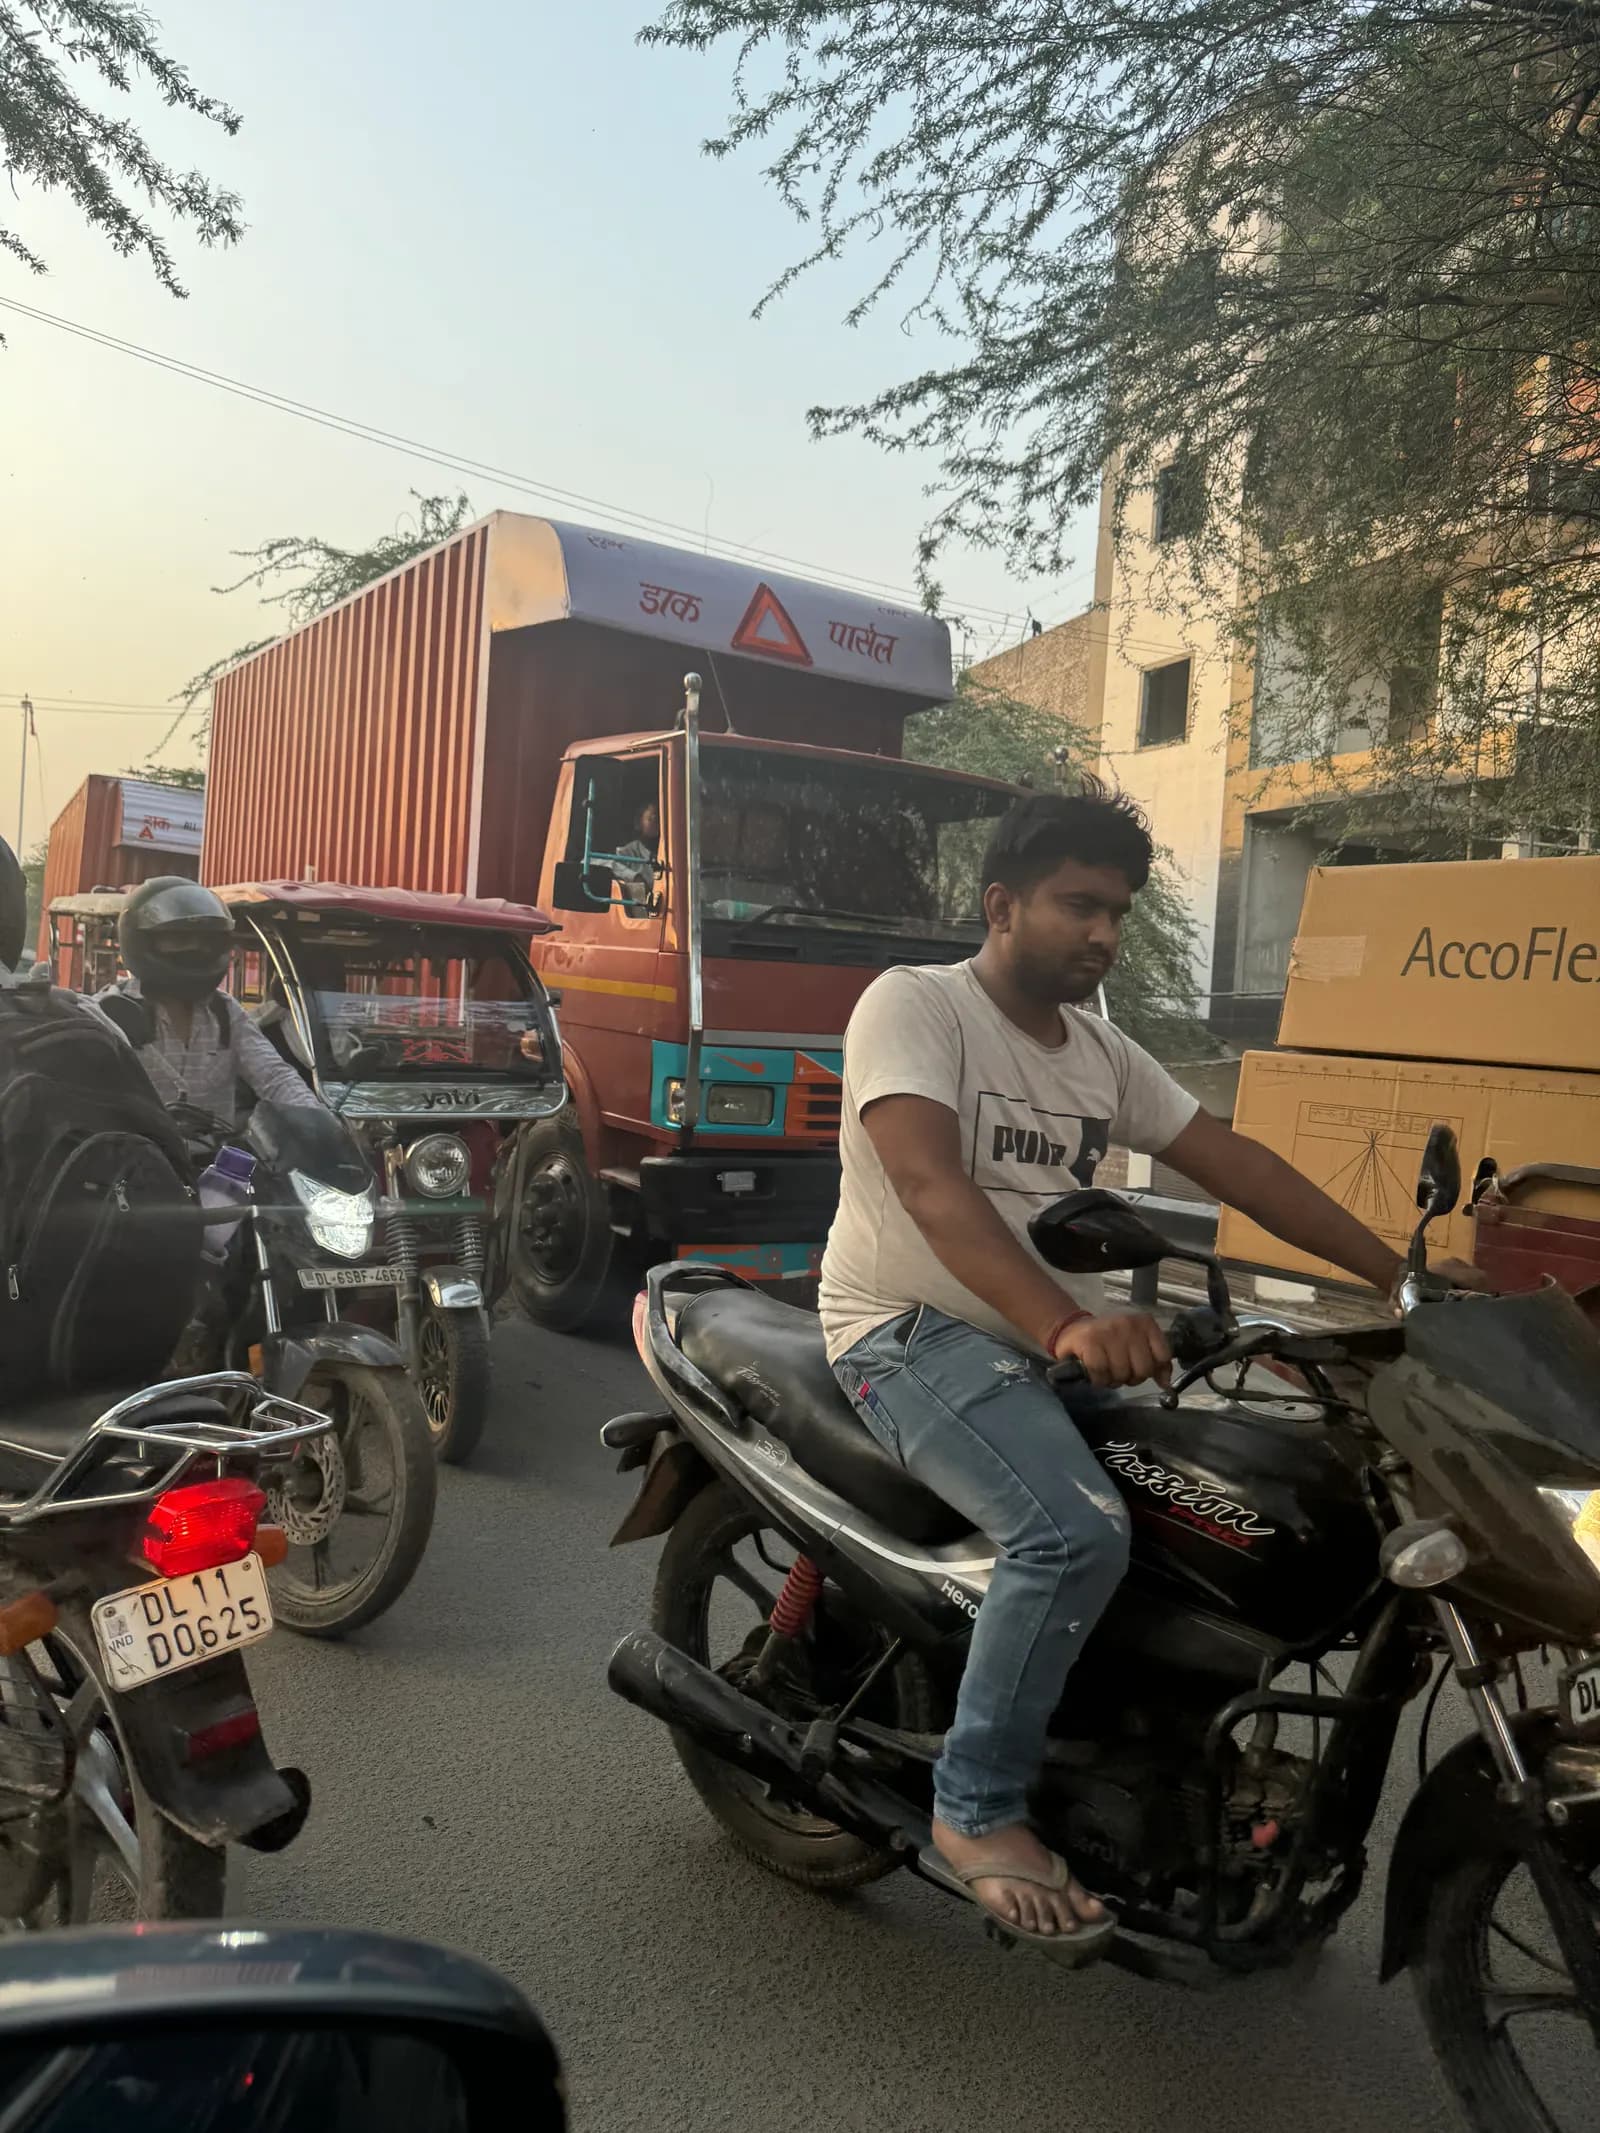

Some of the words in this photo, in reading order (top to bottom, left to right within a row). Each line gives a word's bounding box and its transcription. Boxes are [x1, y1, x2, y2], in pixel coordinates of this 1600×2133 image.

[639, 583, 703, 623] डाक
[1400, 926, 1600, 983] AccoFle
[140, 1585, 188, 1626] DL
[192, 1568, 231, 1606] 11
[941, 1578, 980, 1619] Hero
[147, 1596, 261, 1668] D0625
